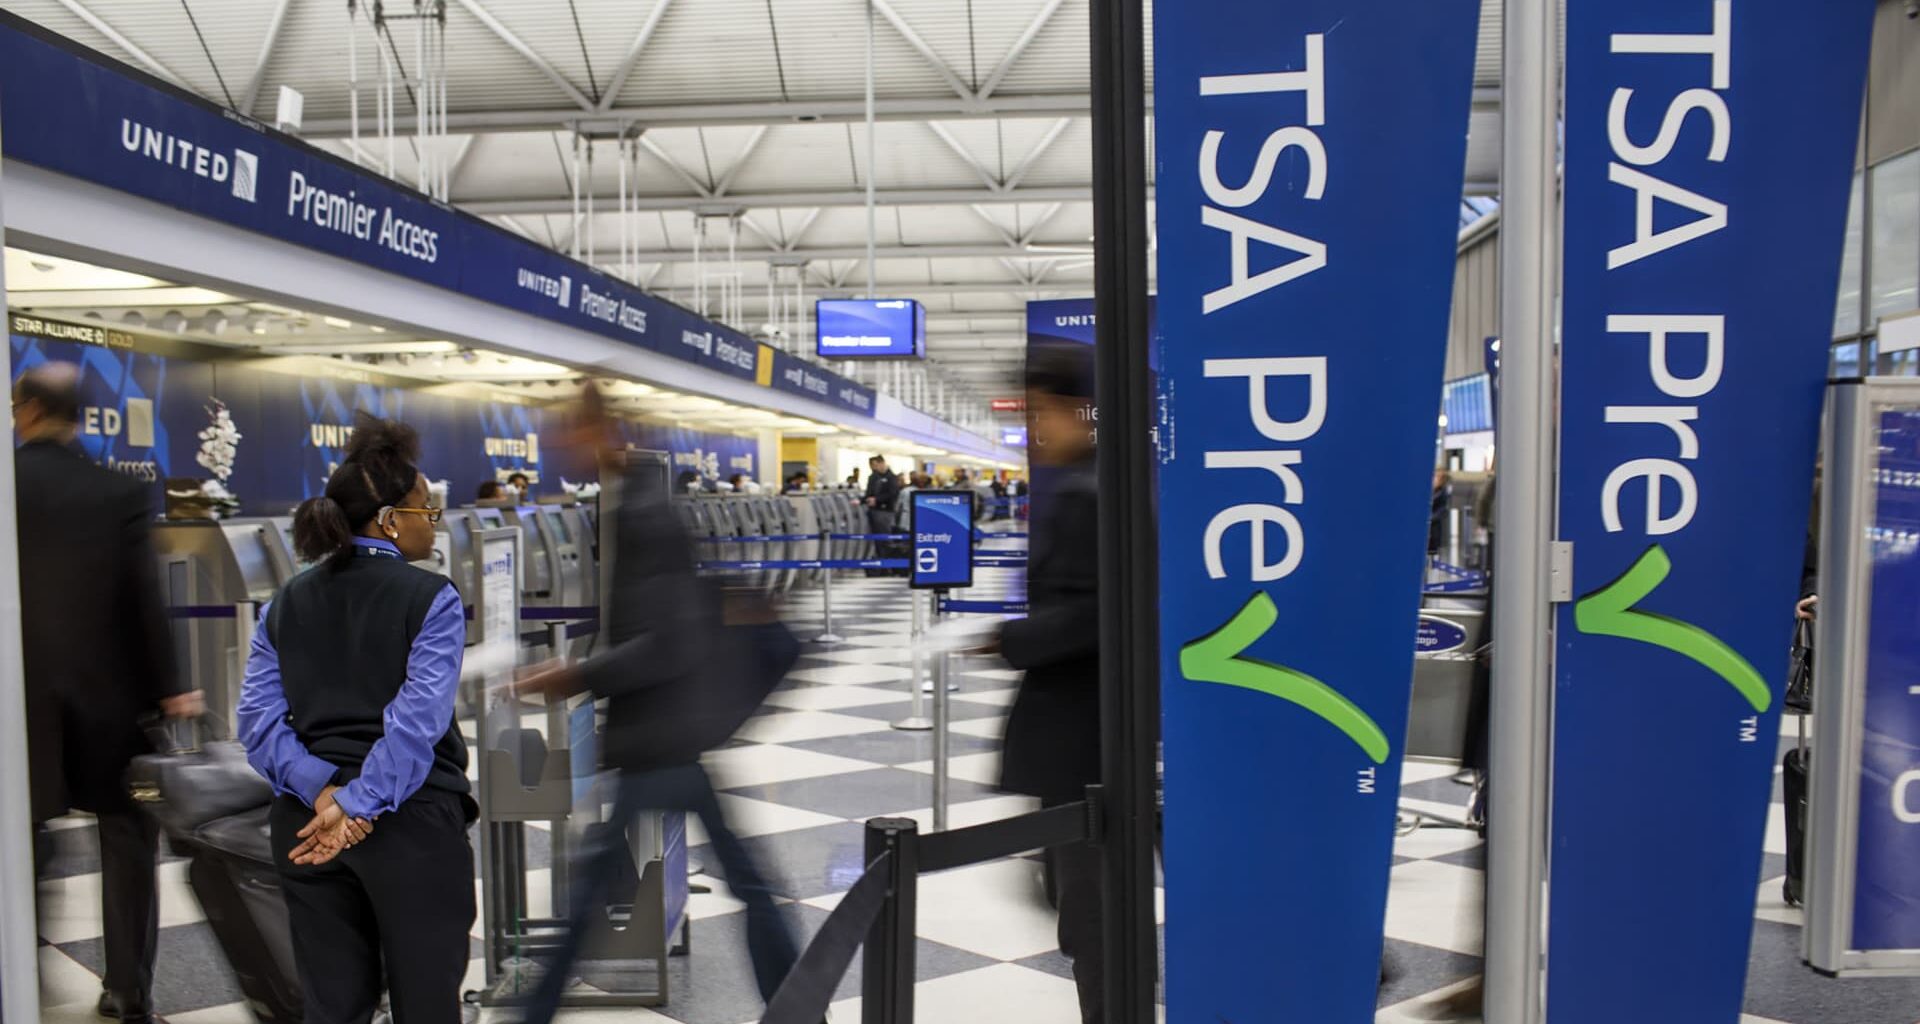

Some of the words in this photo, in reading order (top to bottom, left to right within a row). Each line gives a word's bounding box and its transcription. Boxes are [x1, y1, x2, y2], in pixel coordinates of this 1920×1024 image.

[122, 118, 229, 183] UNITED
[1608, 0, 1732, 270] TSA
[1200, 33, 1327, 315] TSA
[288, 171, 376, 241] Premier
[378, 207, 439, 263] Access
[517, 268, 559, 299] UNITED
[580, 283, 619, 323] Premier
[617, 299, 647, 334] Access
[15, 317, 43, 334] STAR
[44, 322, 94, 342] ALLIANCE
[1055, 315, 1096, 327] UNIT
[484, 437, 527, 457] UNITED
[1602, 315, 1725, 534] Pre
[1203, 357, 1328, 581] Pre
